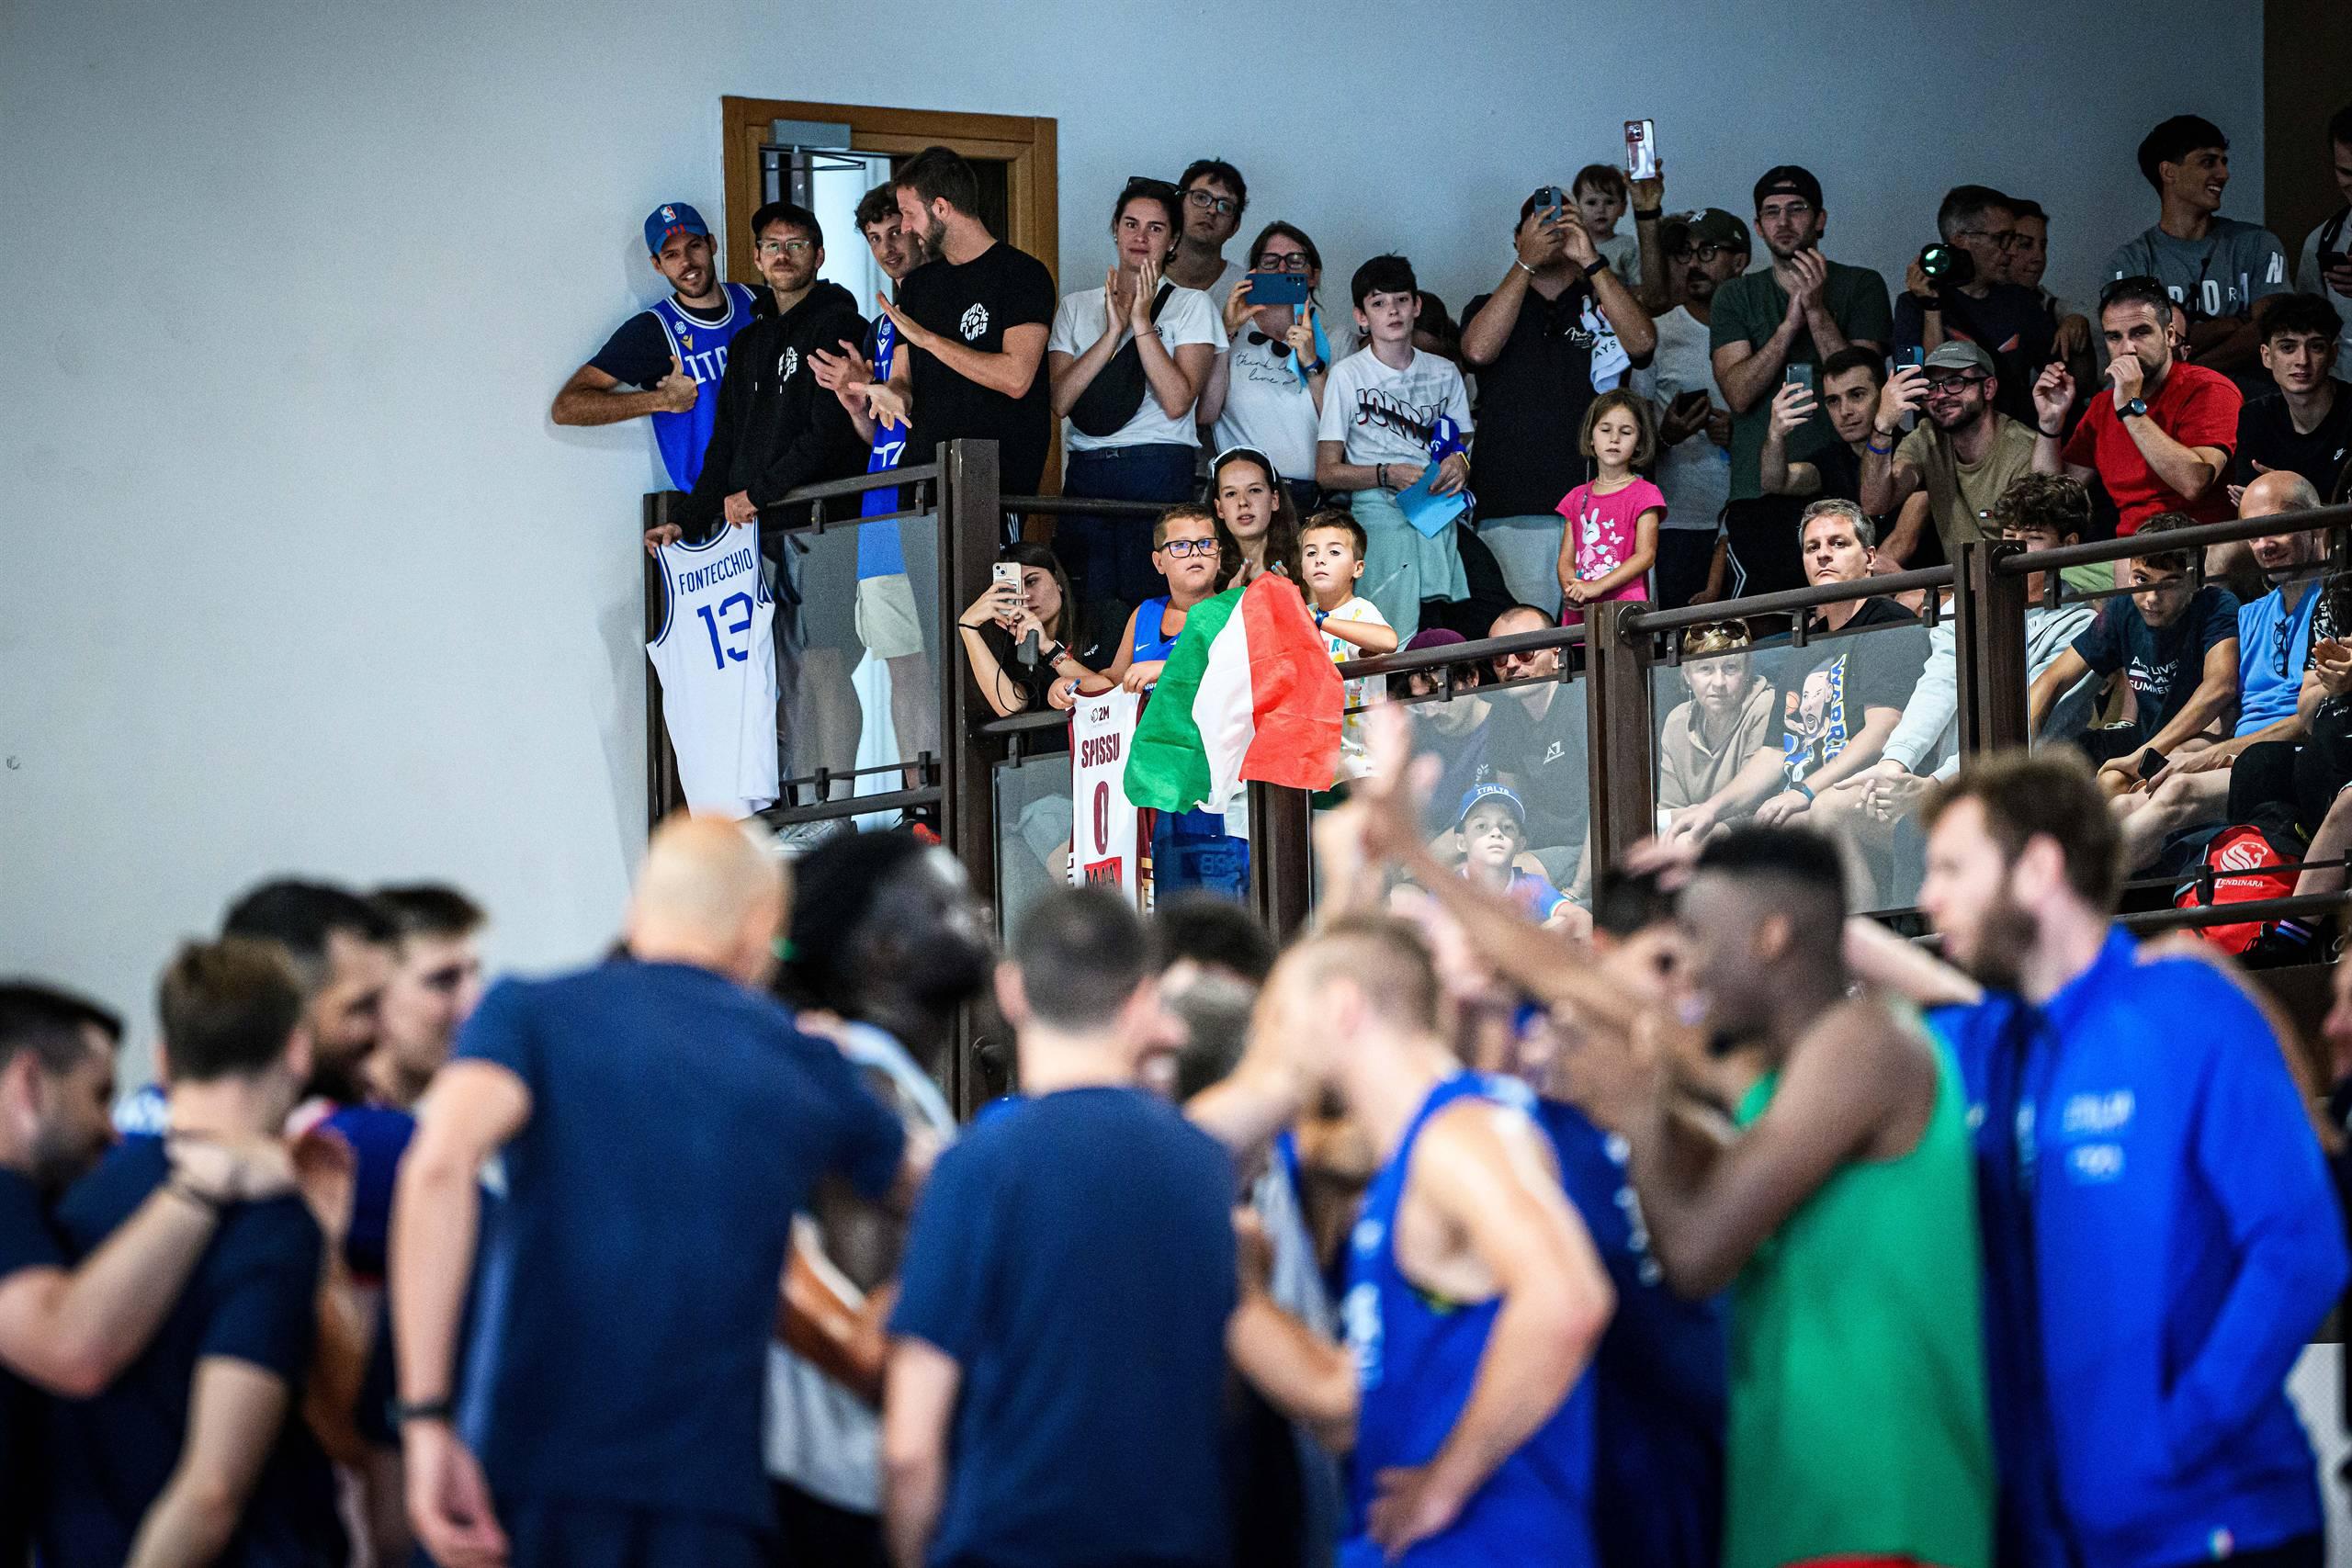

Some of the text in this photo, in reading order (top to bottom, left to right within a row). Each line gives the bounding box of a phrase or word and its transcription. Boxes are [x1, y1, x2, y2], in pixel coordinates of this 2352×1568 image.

[962, 302, 989, 322] BACK
[967, 314, 980, 326] TO
[959, 321, 988, 341] PLAY
[679, 547, 753, 596] FONTECCHIO
[696, 591, 753, 671] 13
[1081, 732, 1121, 769] SPISSU
[1093, 780, 1109, 856] 0
[2214, 878, 2264, 889] LENDINARA
